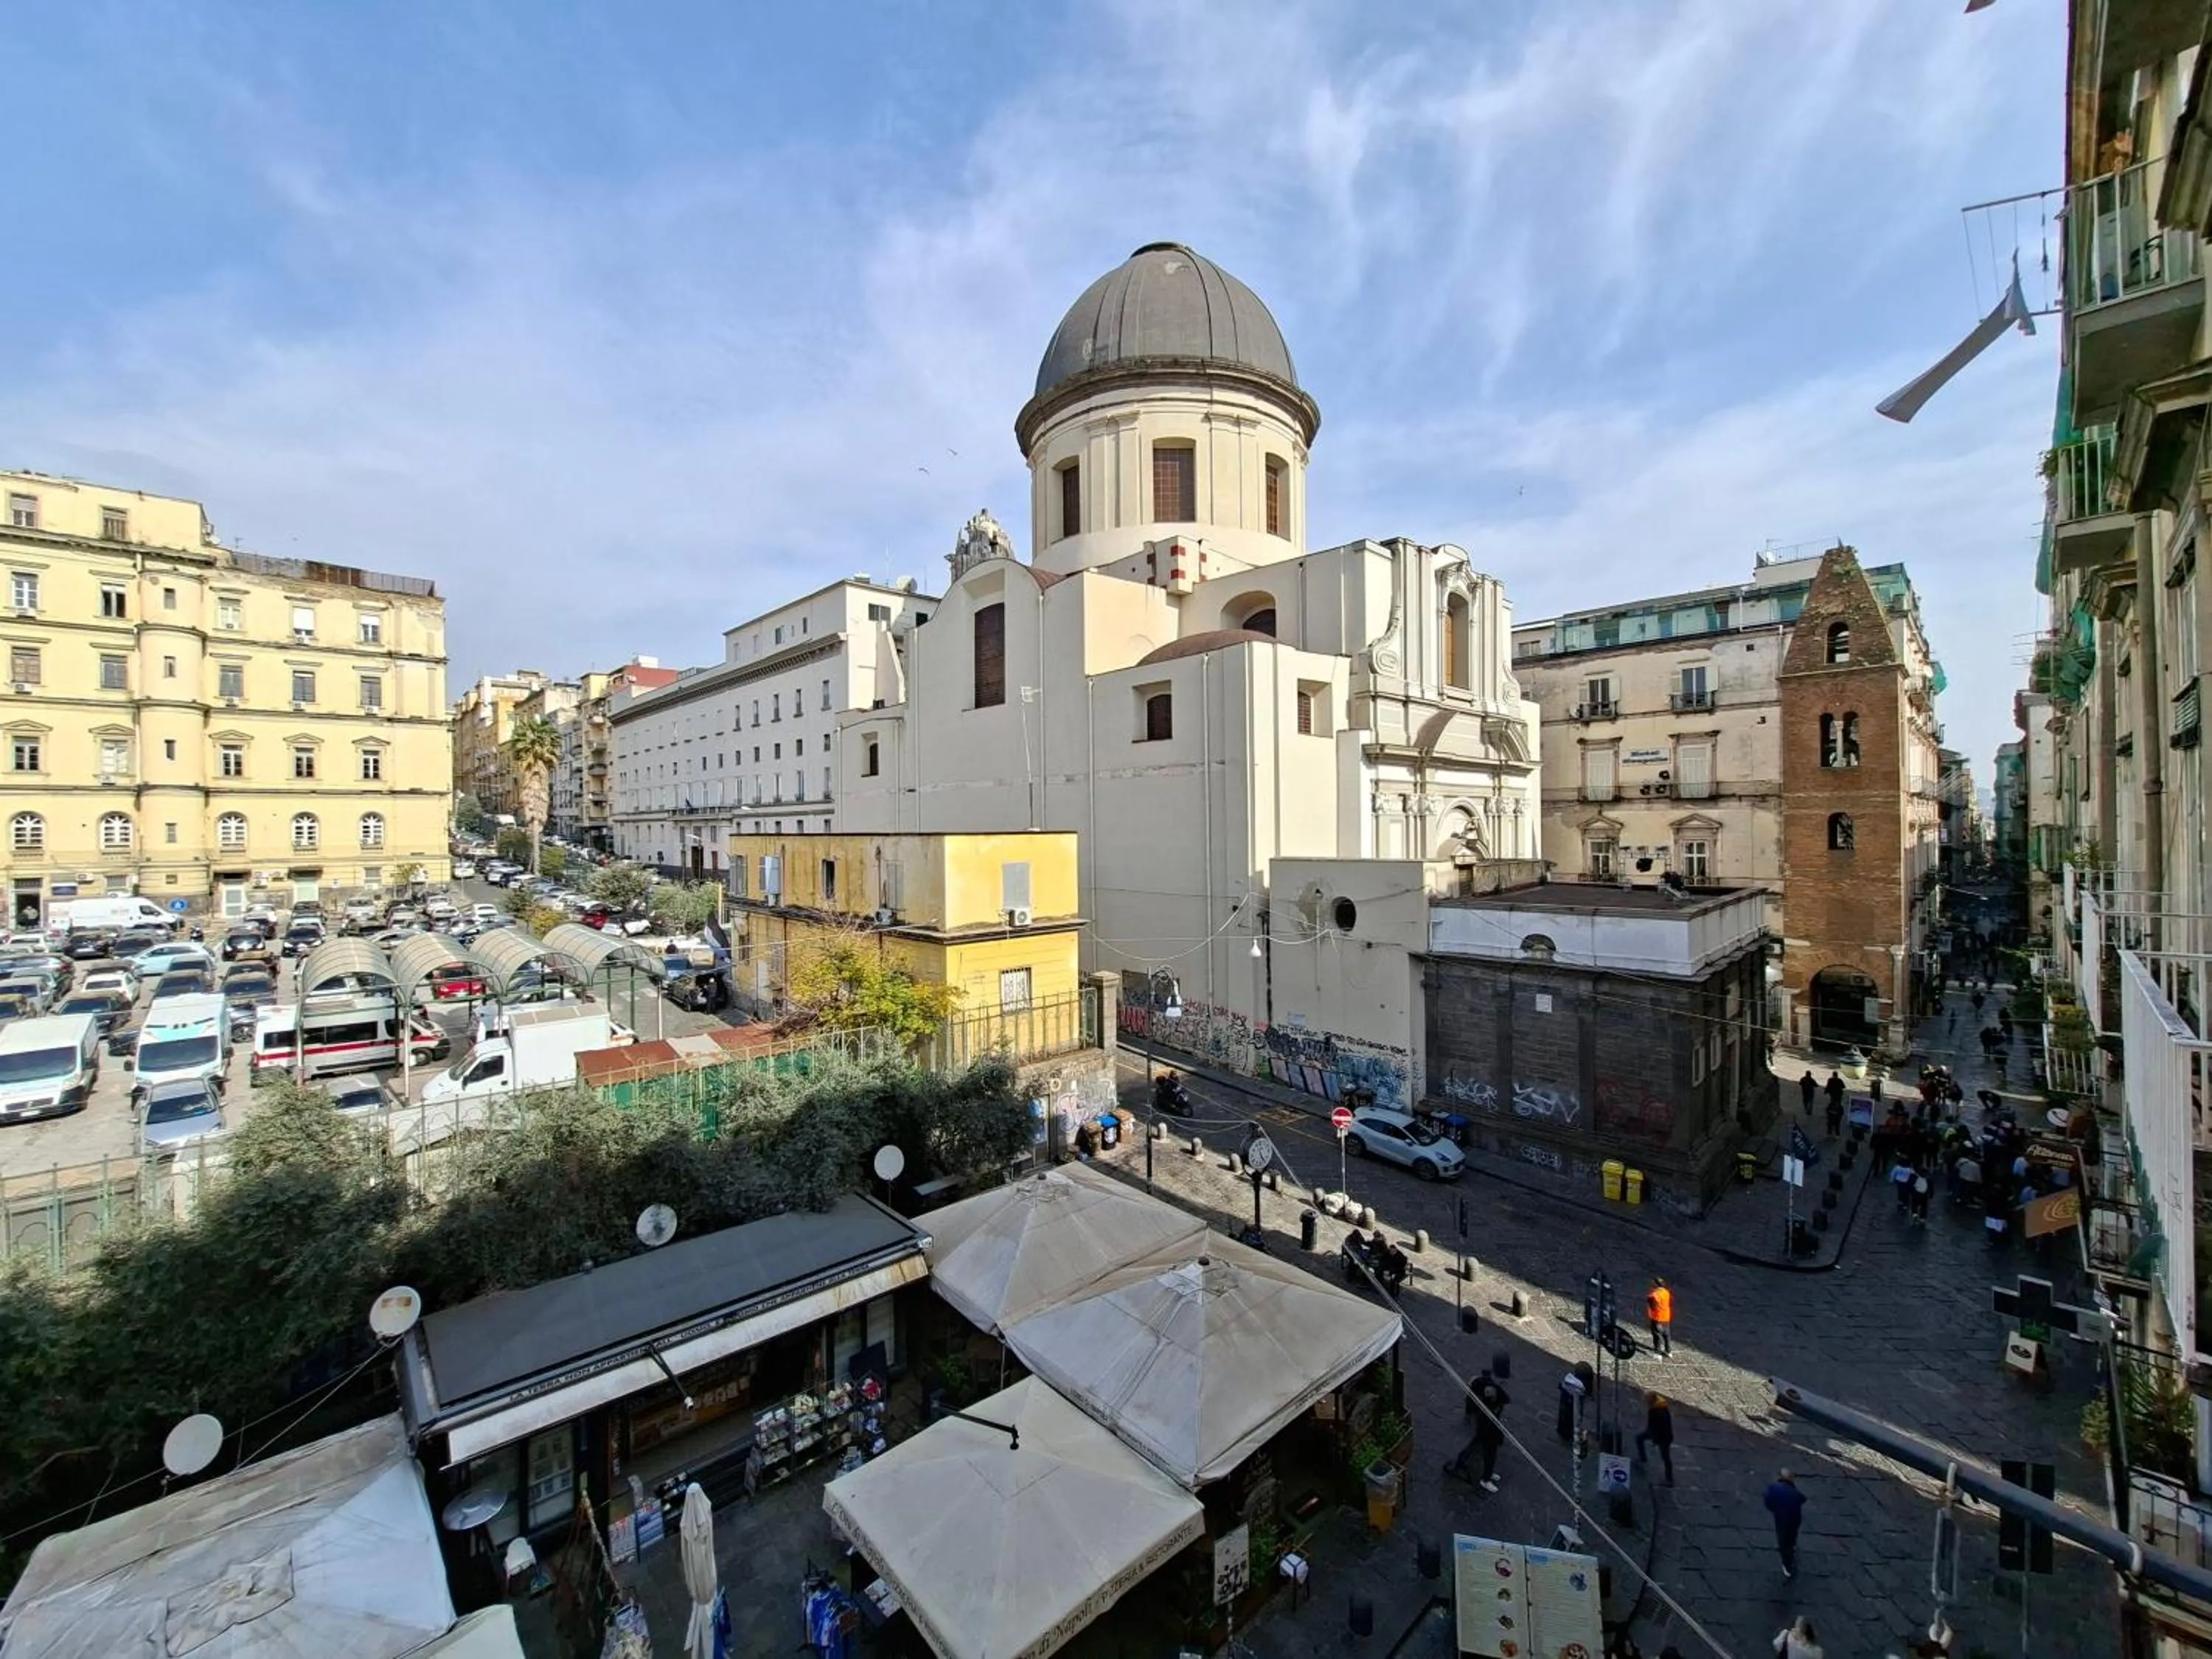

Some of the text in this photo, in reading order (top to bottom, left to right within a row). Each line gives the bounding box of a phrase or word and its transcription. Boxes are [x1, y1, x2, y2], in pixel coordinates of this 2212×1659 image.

[592, 1345, 655, 1370] APPARTIEN
[1053, 1596, 1093, 1637] Napoli
[1102, 1568, 1138, 1604] PIZZERIA
[1145, 1523, 1194, 1565] RISTORANTE
